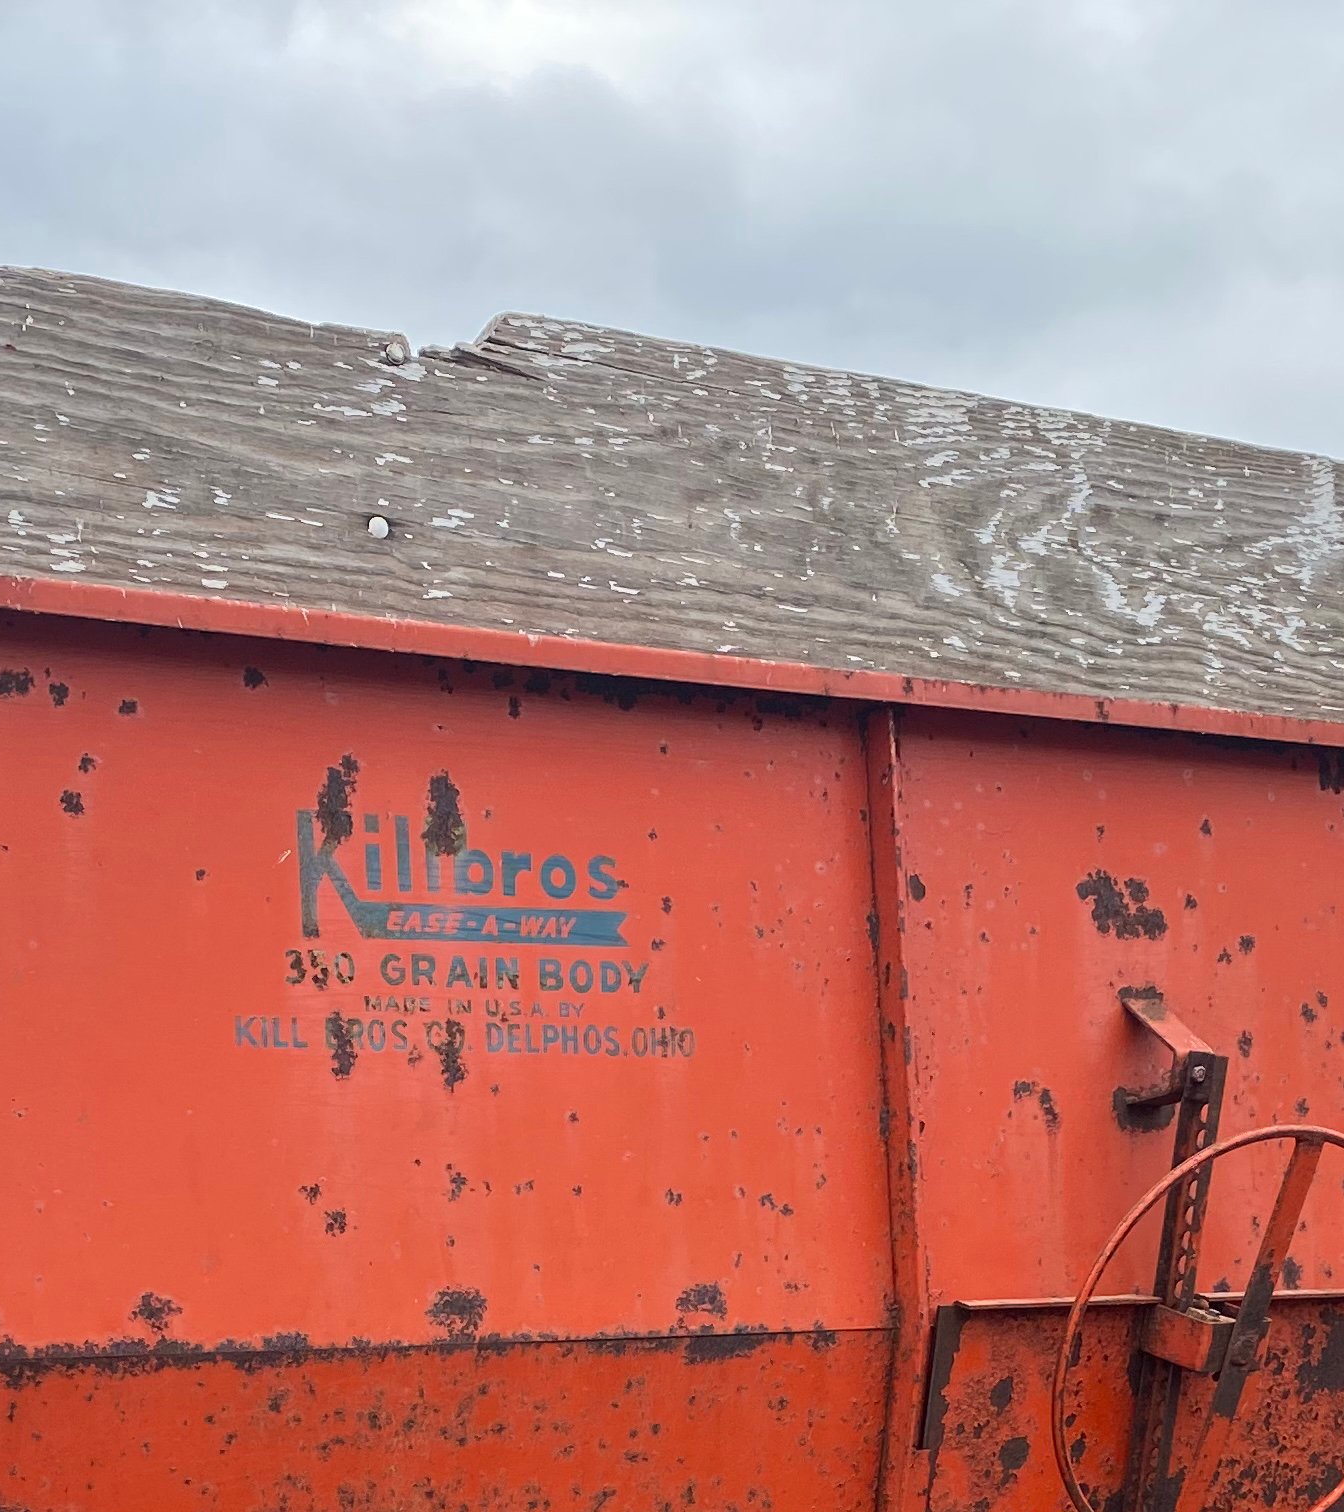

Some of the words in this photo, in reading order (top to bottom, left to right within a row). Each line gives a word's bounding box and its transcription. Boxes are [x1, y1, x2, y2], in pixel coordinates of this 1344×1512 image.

[296, 809, 618, 938] Killbros
[386, 910, 577, 939] EASE-A-WAY
[285, 950, 355, 986] 350
[380, 953, 520, 990] GRAIN
[538, 957, 650, 994] BODY
[363, 995, 432, 1014] MADE
[447, 998, 472, 1014] IN
[559, 1001, 585, 1018] BY
[234, 1014, 309, 1050] KILL
[324, 1014, 408, 1053] BROS
